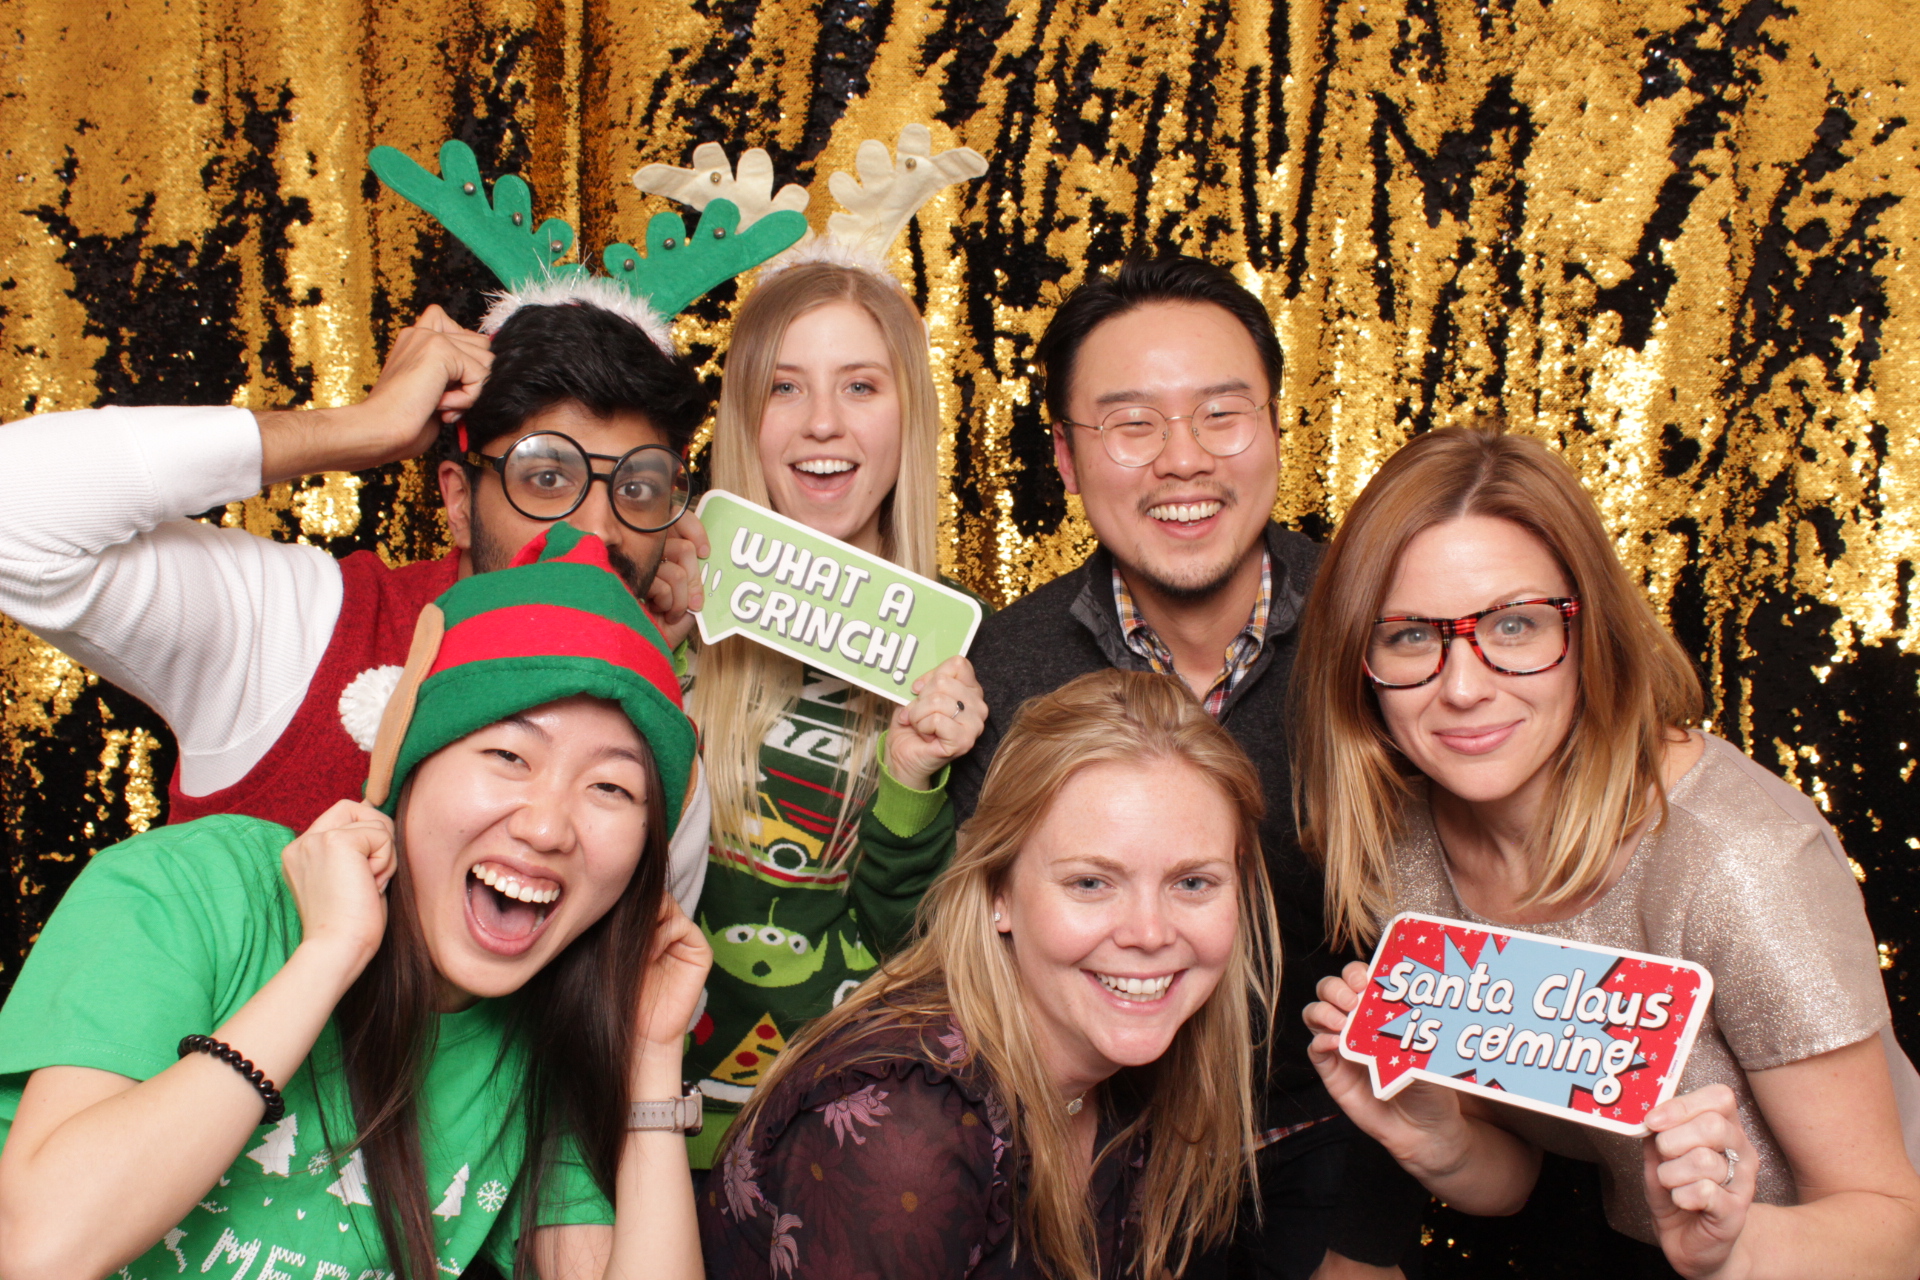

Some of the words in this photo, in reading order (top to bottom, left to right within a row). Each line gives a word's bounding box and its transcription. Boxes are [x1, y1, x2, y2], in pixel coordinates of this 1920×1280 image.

[730, 526, 869, 606] WHAT
[878, 582, 914, 626] A
[729, 581, 918, 684] GRINCH!
[1532, 968, 1674, 1030] Claus
[1400, 1008, 1443, 1053] is
[1455, 1023, 1640, 1105] coming
